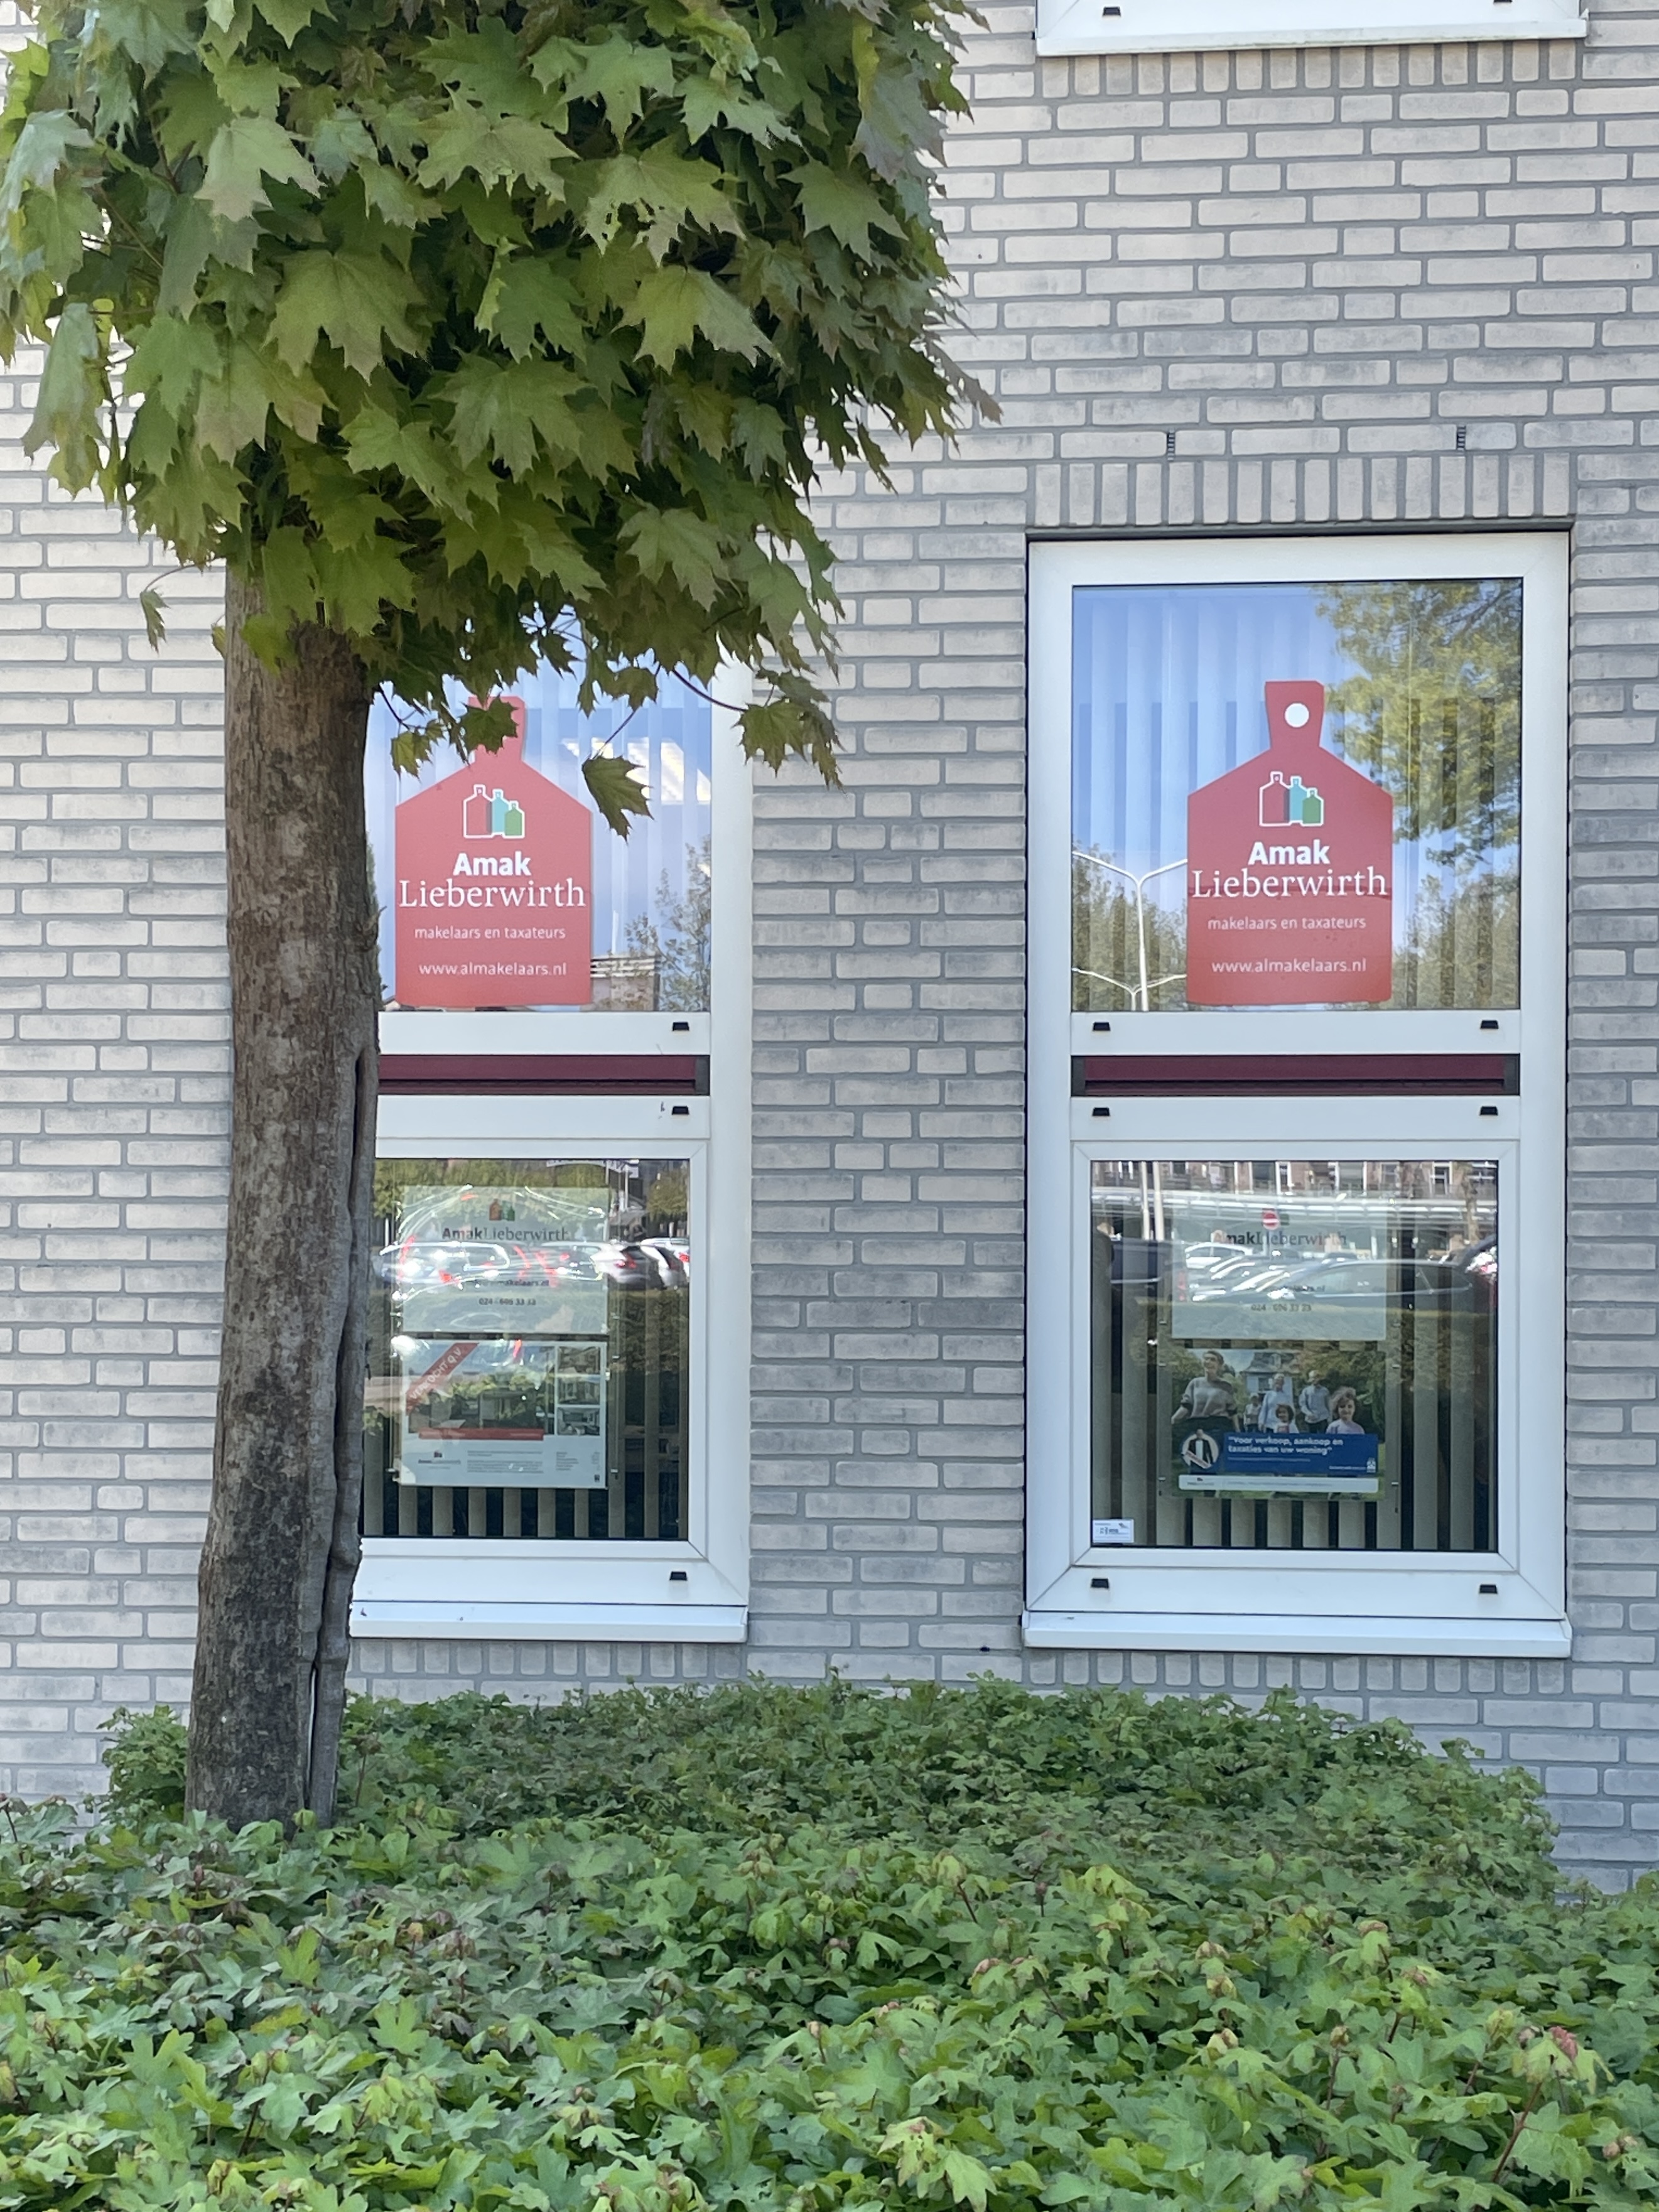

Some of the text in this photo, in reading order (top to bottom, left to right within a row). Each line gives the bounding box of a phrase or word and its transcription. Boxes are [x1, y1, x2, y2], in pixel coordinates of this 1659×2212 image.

[1248, 839, 1331, 865] Amak
[452, 850, 532, 877] Amak
[1191, 865, 1388, 898] Lieberwirth
[399, 878, 586, 908] Lieberwirth
[414, 925, 566, 939] makelaars en taxateurs
[1208, 916, 1367, 930] makelaars en taxateurs
[419, 962, 567, 976] www.almakelaars.nl
[1211, 958, 1367, 973] www.almakelaars.nl
